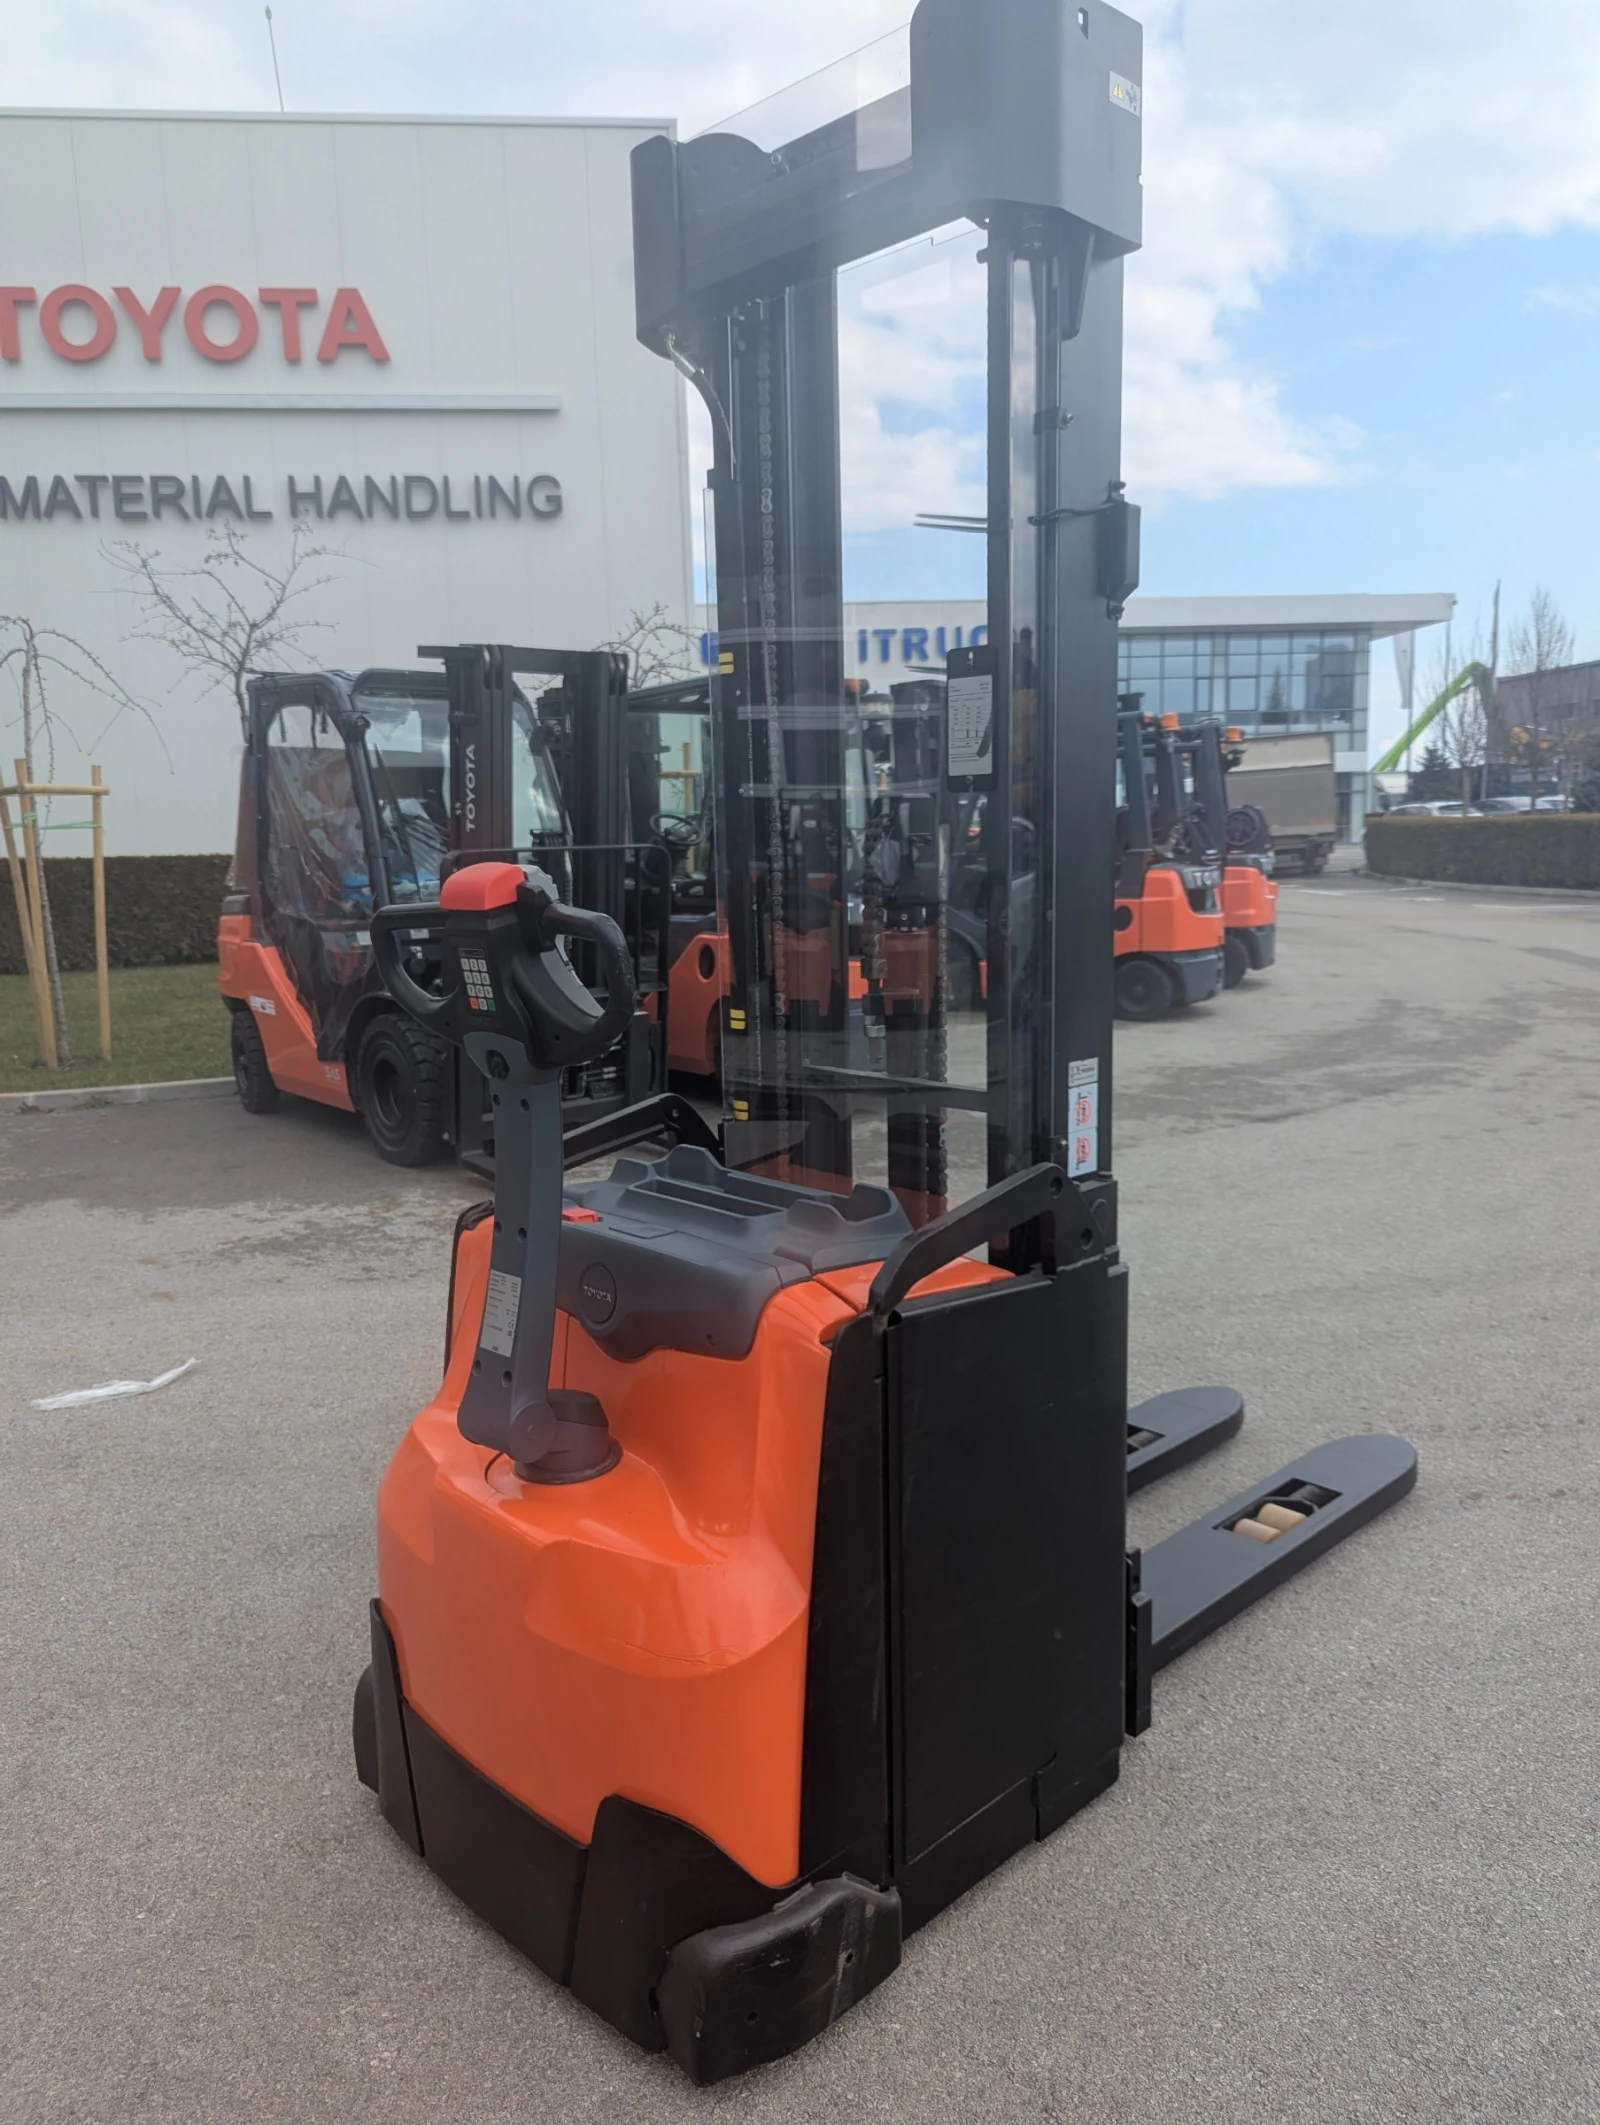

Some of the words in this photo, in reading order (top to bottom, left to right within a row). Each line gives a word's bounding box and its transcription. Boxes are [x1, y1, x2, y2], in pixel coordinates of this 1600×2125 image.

[0, 284, 390, 363] TOYOTA
[0, 474, 272, 521] MATERIAL
[287, 474, 563, 521] HANDLING
[465, 744, 476, 832] TOYOTA
[583, 1286, 612, 1303] TOYOTA
